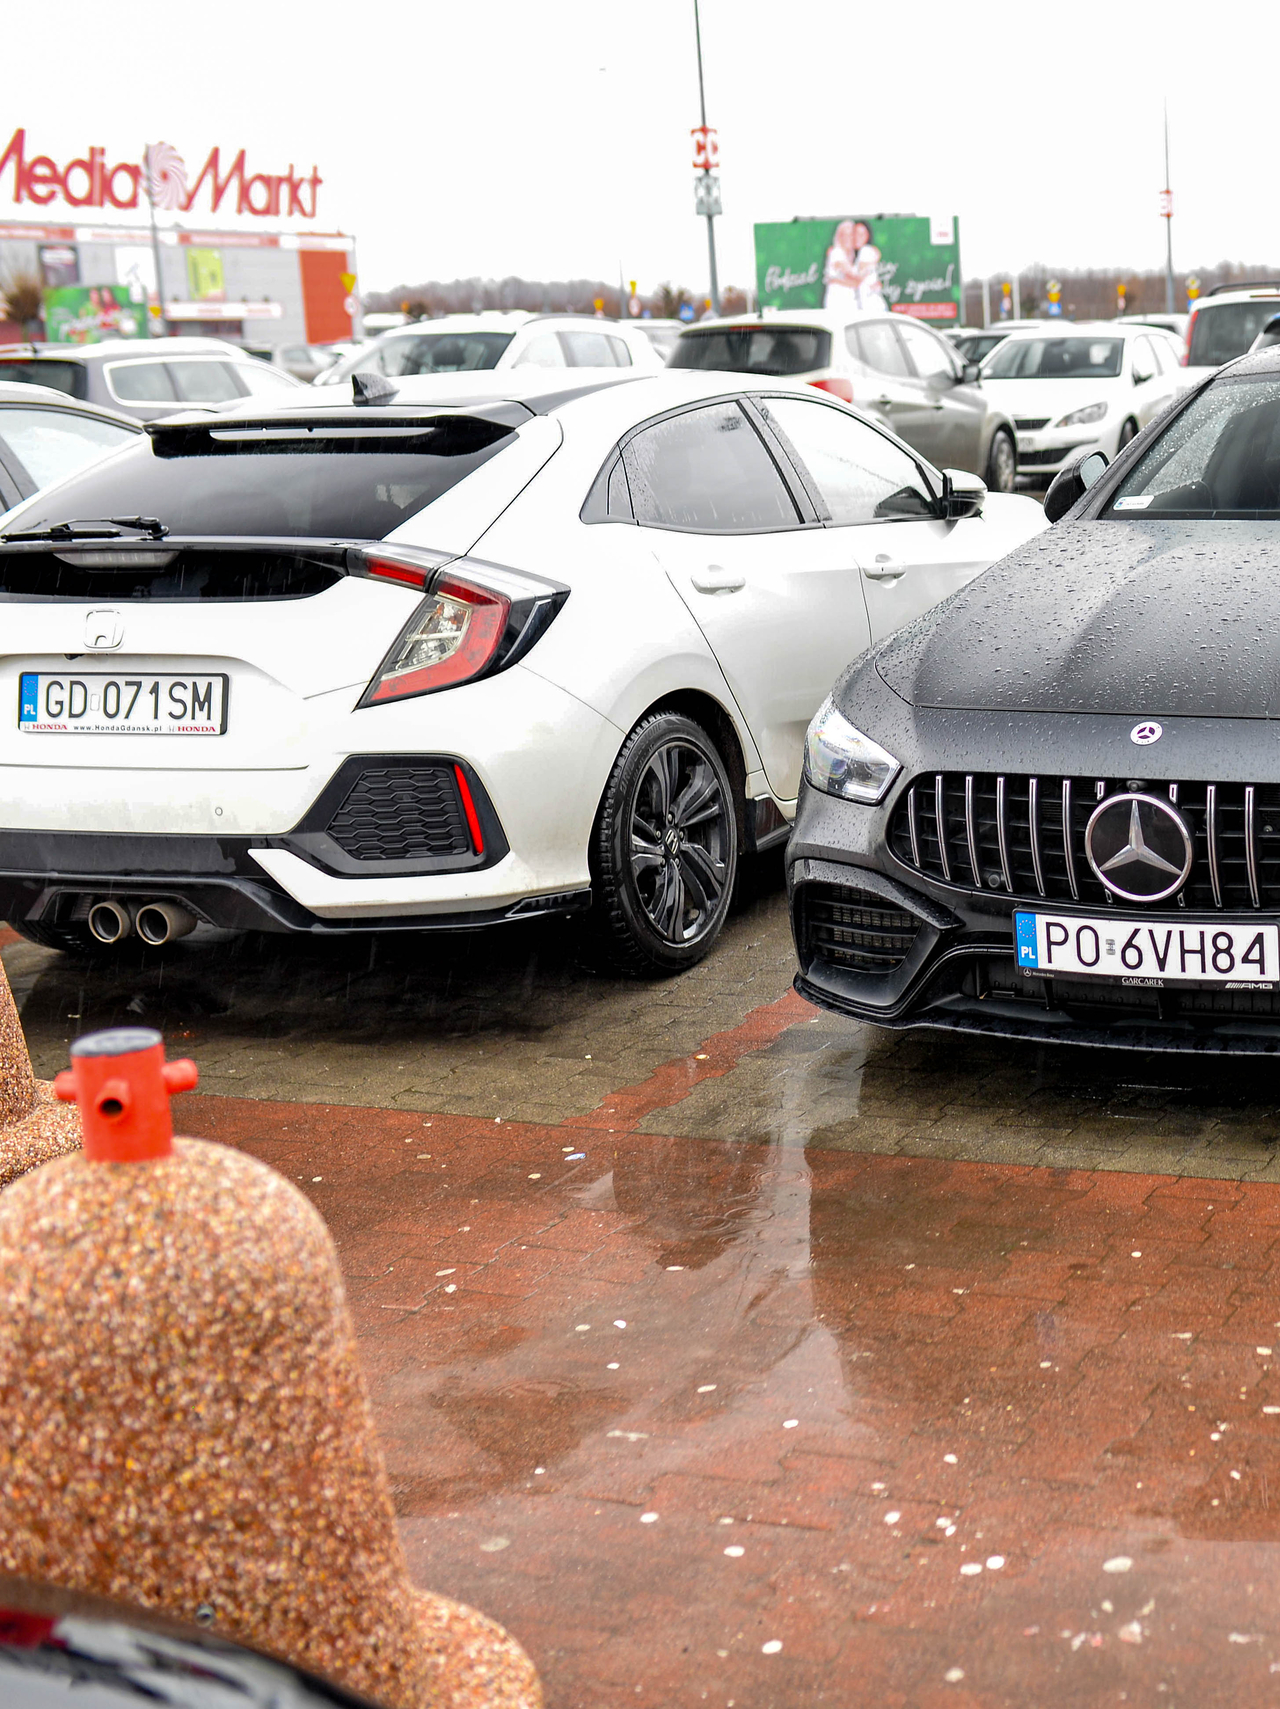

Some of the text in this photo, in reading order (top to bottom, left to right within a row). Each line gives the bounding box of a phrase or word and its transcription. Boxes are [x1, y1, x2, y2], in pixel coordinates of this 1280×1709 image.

[180, 146, 322, 217] Markt
[45, 680, 213, 721] GD 071SM
[24, 704, 36, 715] PL
[73, 725, 163, 733] www.HondaGdansk.pl
[1020, 946, 1036, 959] PL
[1045, 921, 1266, 975] PO 6VH84
[1121, 976, 1164, 986] GARCAREK
